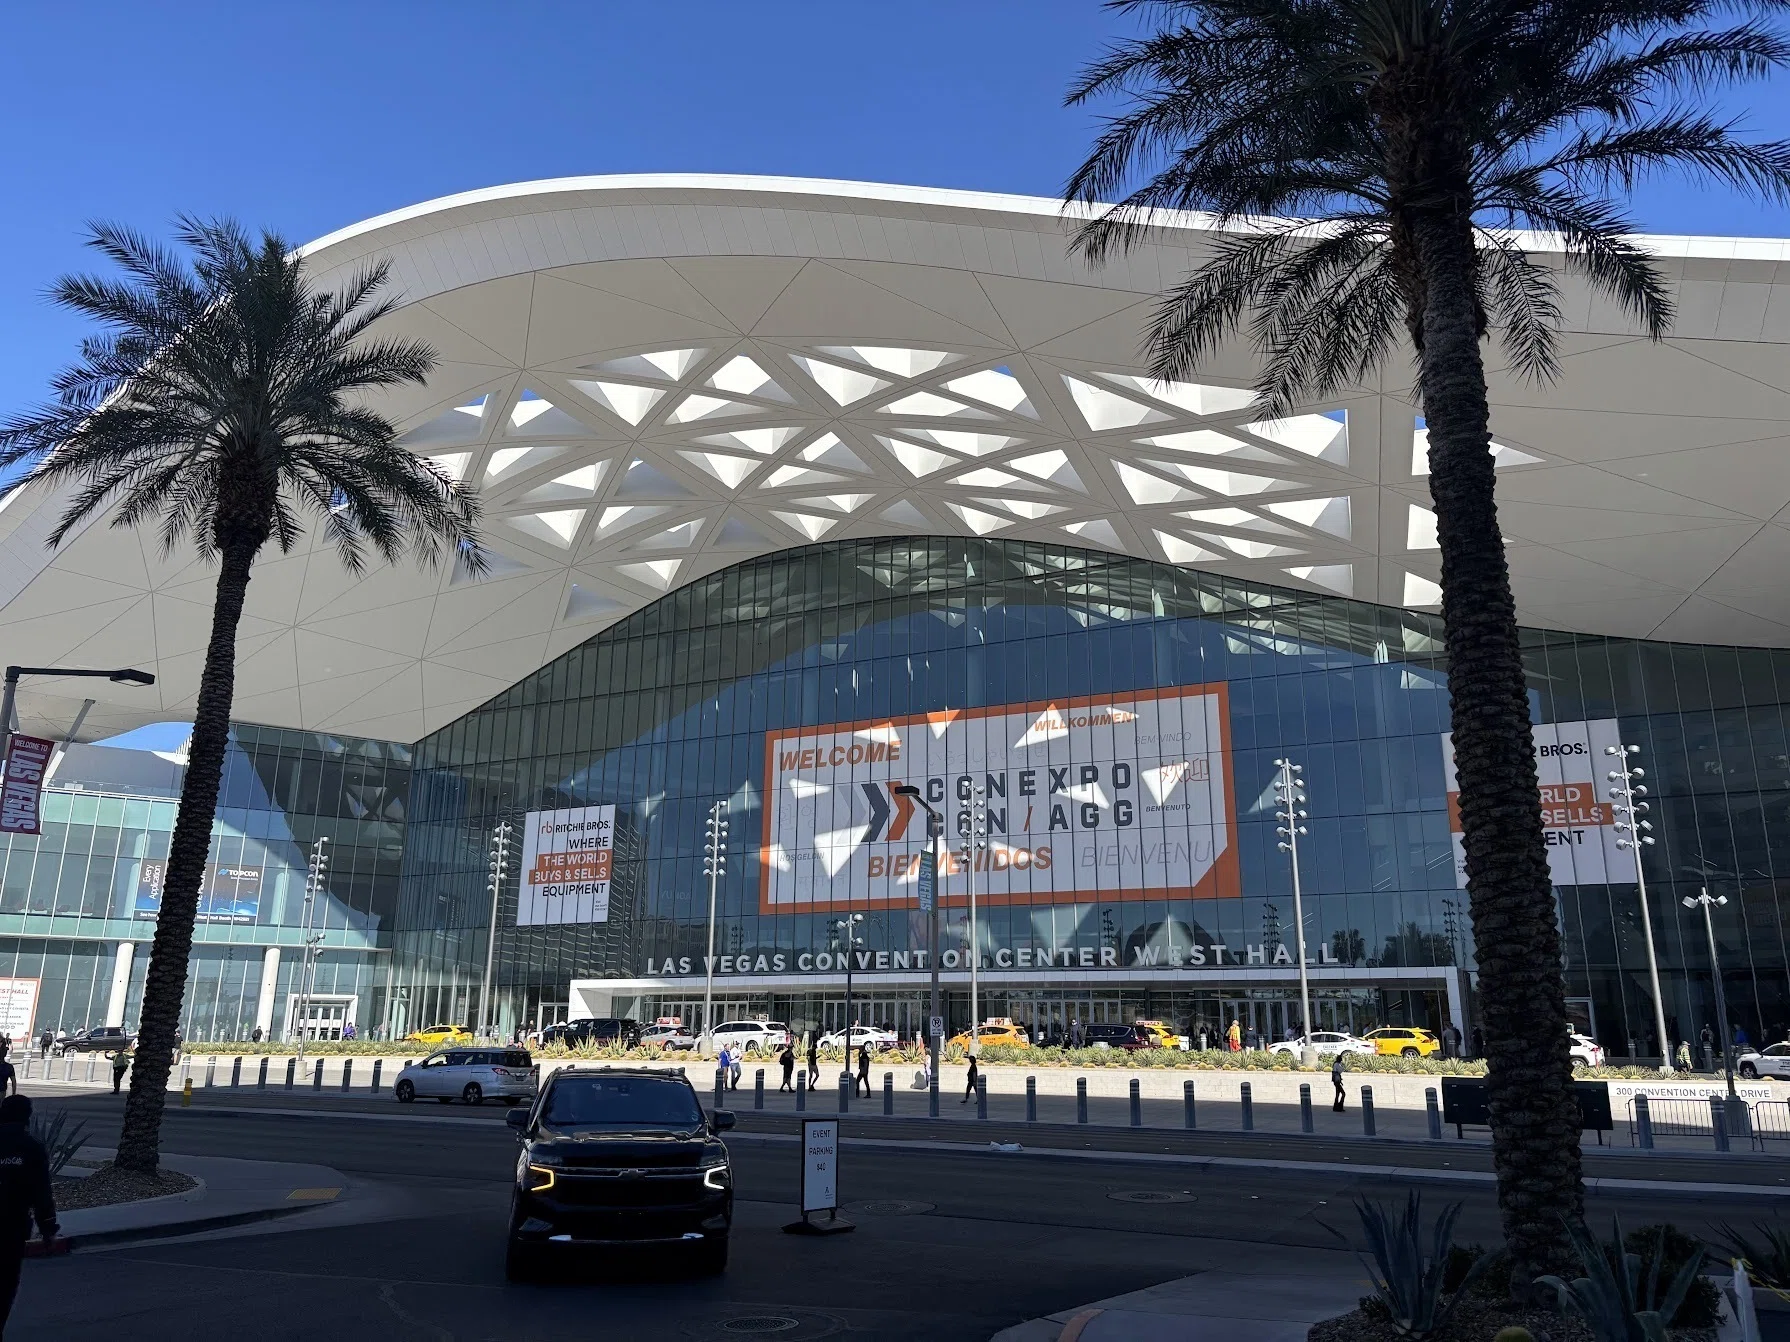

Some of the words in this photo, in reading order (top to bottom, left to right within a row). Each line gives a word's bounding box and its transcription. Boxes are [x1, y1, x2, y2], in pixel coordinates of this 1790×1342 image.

[1034, 712, 1132, 732] WILLKOMMEN
[15, 740, 41, 751] WELCOME
[41, 744, 48, 752] TO
[1134, 732, 1192, 745] BEM-VINDO
[779, 740, 902, 771] WELCOME
[8, 749, 46, 780] LAS
[927, 763, 1131, 803] CONEXPO
[1539, 787, 1581, 803] RLD
[1, 781, 38, 830] VEGAS
[1145, 804, 1191, 812] BENVENUTO
[1540, 807, 1603, 825] SELLS
[555, 823, 584, 833] RITCHIE
[569, 837, 609, 849] WHERE
[544, 855, 565, 866] THE
[567, 852, 608, 865] WORLD
[1081, 840, 1211, 867] BIENVENU
[149, 865, 162, 899] Application
[534, 870, 562, 882] BUYS
[564, 870, 572, 880] &
[574, 867, 607, 879] SELLS
[542, 883, 606, 897] EQUIPMENT
[919, 880, 932, 911] VEGAS
[647, 957, 692, 975] LAS
[703, 953, 786, 973] VEGAS
[798, 949, 982, 971] CONVENTON
[996, 945, 1118, 967] CENTER
[1134, 944, 1227, 966] WEST
[1616, 1087, 1632, 1096] 300
[1635, 1088, 1697, 1097] CONVENTION
[1699, 1089, 1737, 1097] CENTE
[1741, 1089, 1771, 1098] DRIVE
[812, 1130, 831, 1138] EVENT
[809, 1146, 833, 1156] PARKING
